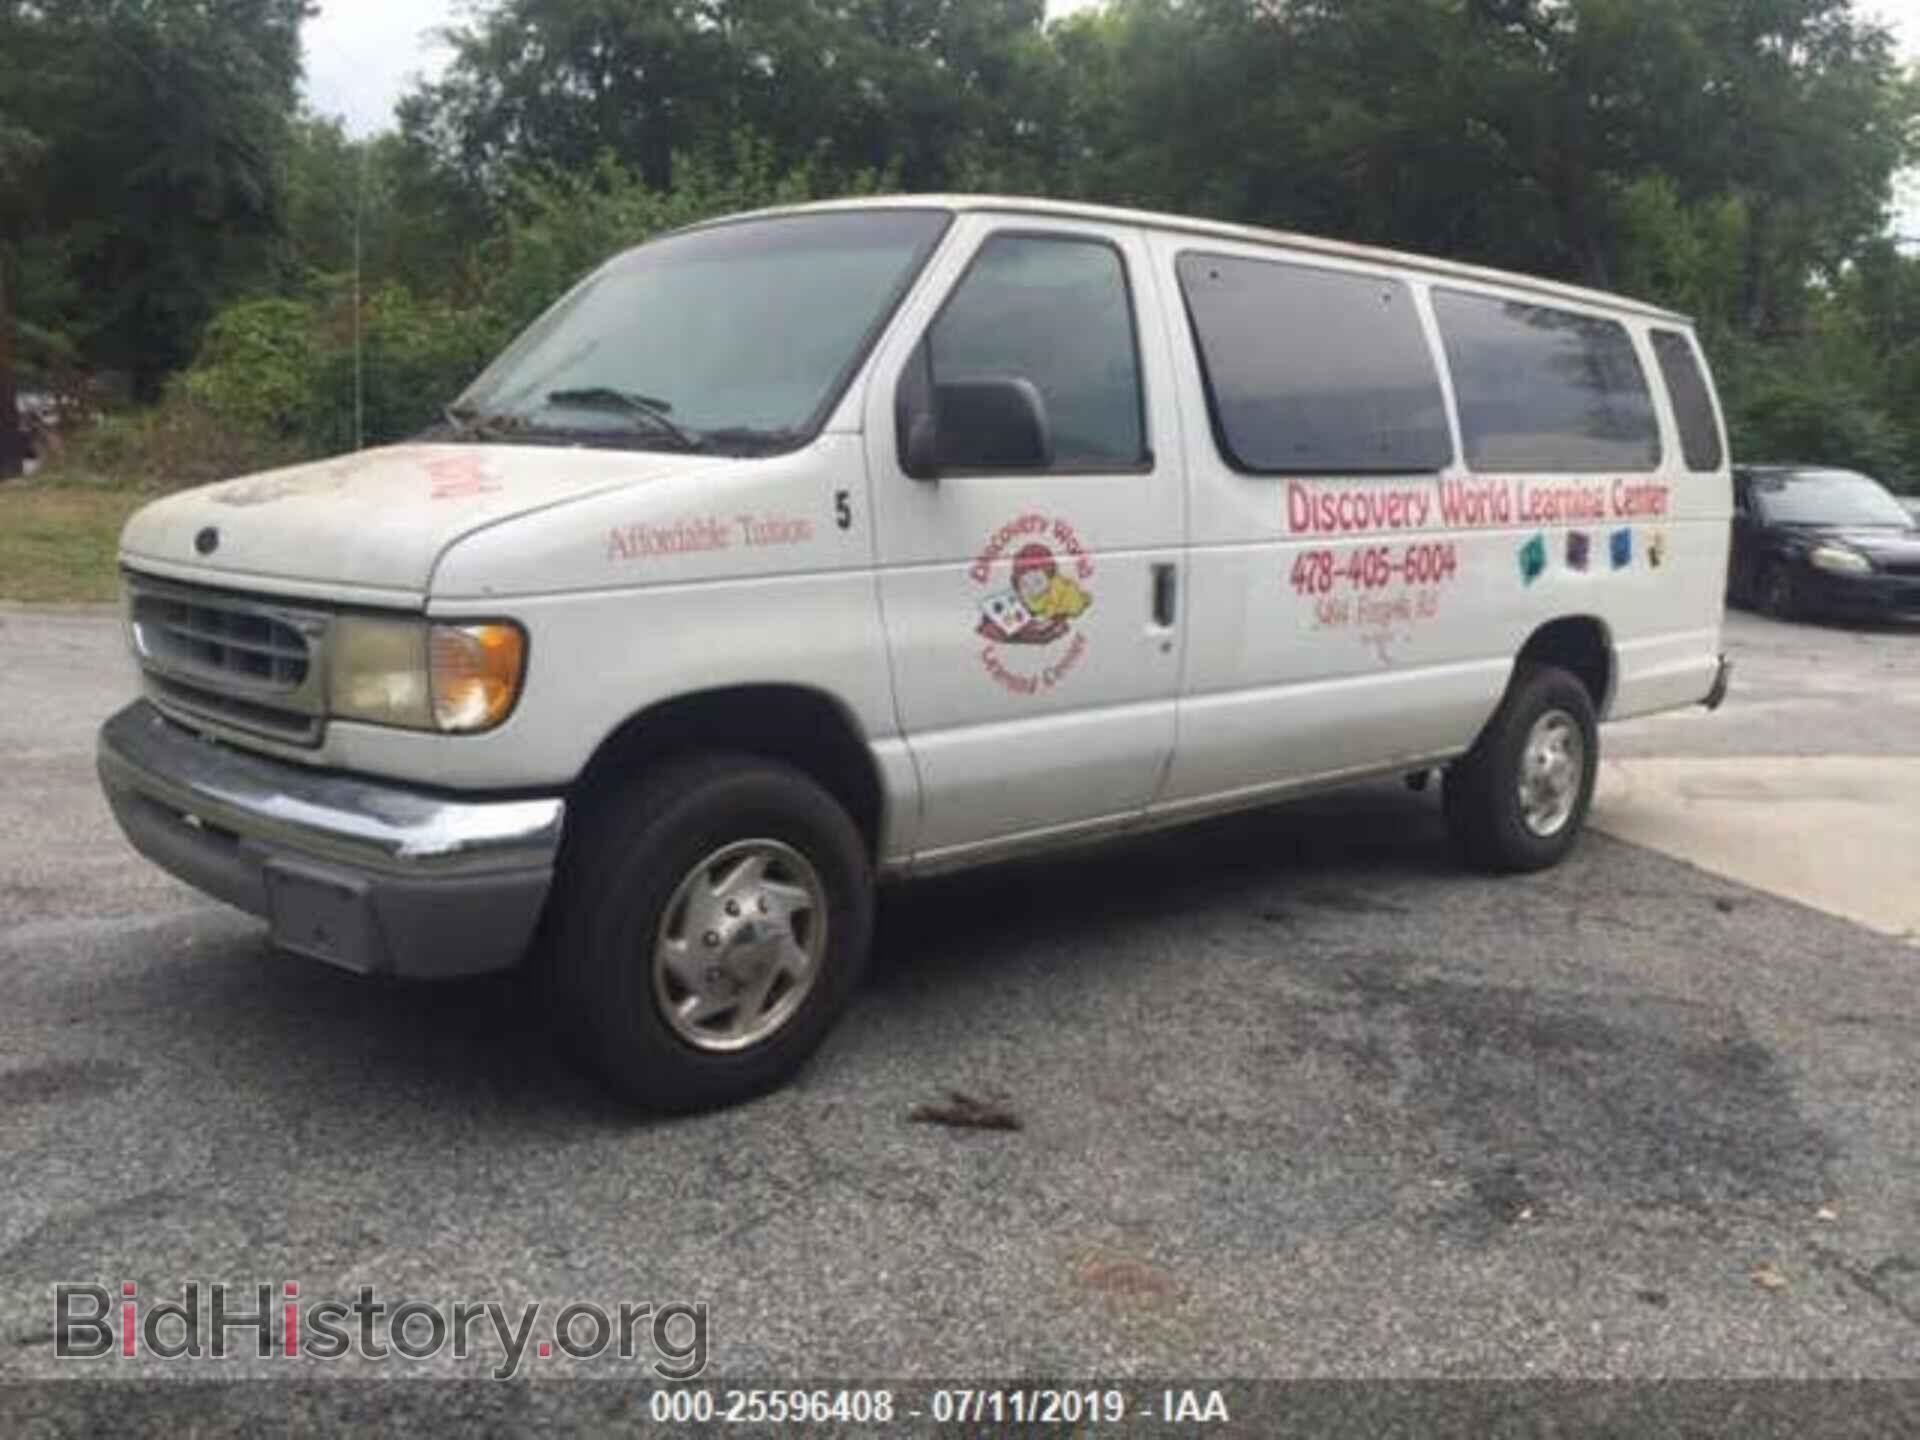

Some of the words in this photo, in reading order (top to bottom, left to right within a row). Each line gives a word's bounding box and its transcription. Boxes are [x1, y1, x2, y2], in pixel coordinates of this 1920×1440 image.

[836, 490, 851, 530] 5
[1288, 480, 1430, 533] Discovery
[1438, 478, 1511, 528] World
[1290, 542, 1457, 595] 478-405-6004
